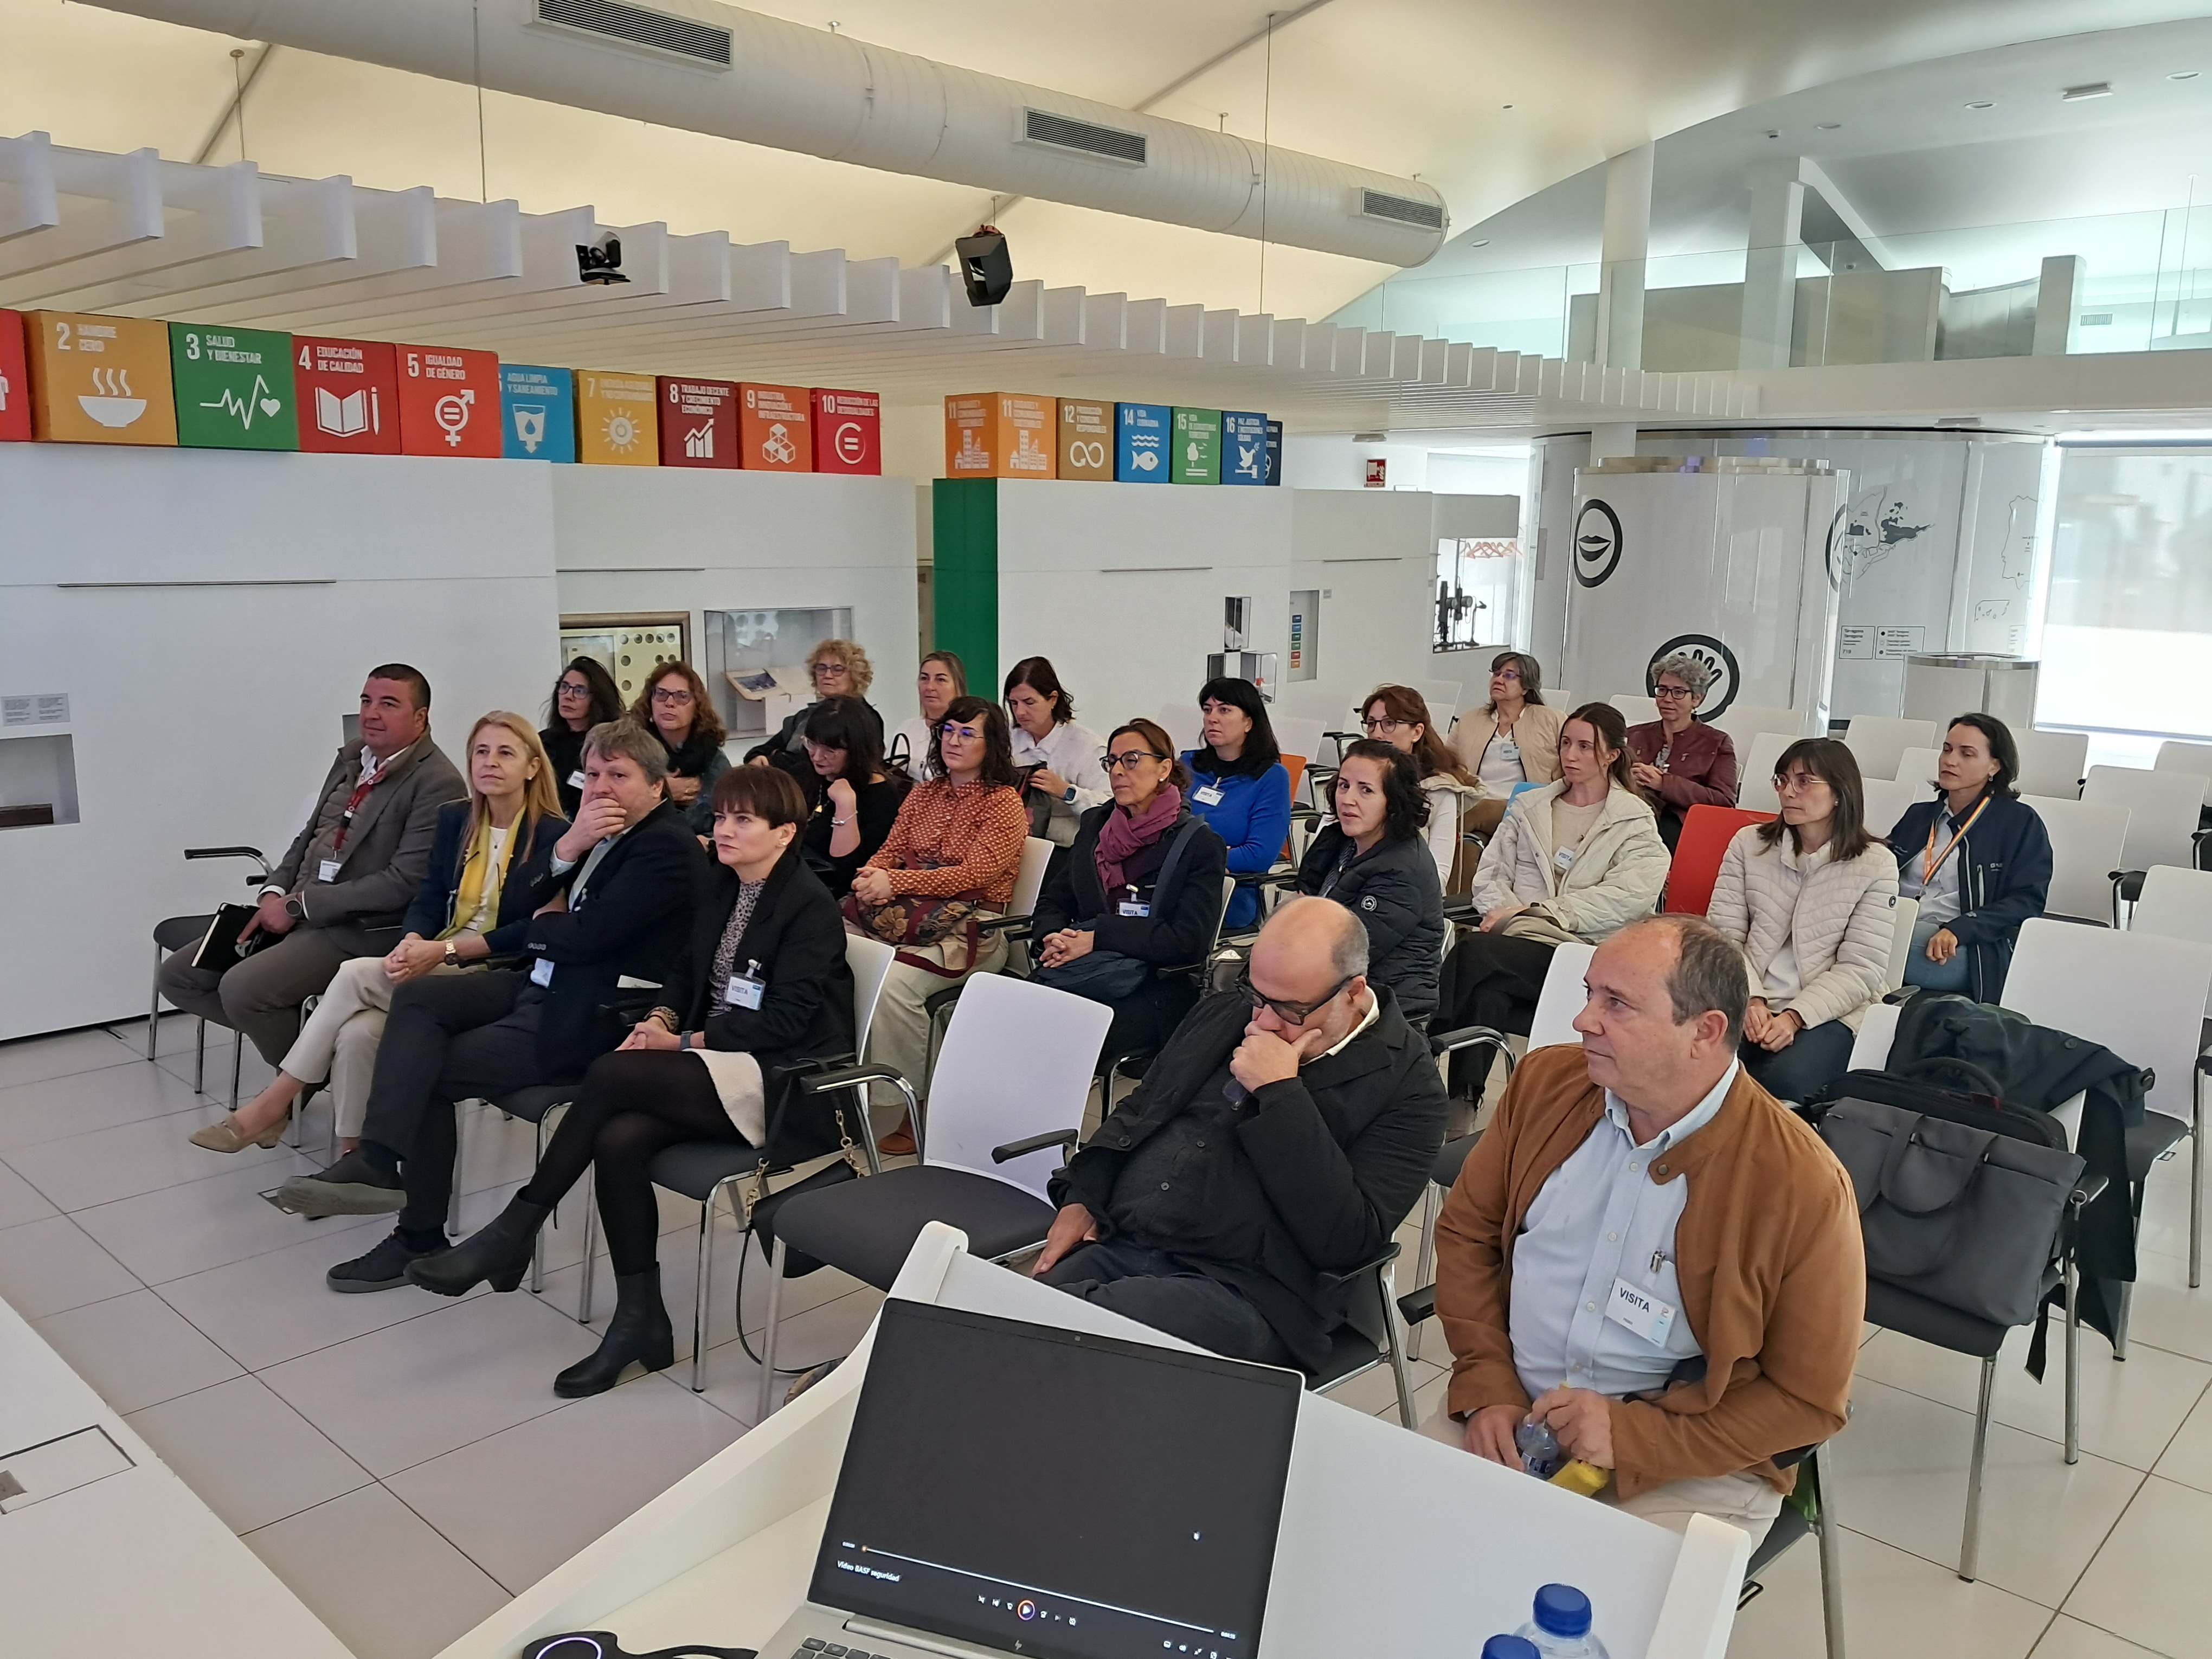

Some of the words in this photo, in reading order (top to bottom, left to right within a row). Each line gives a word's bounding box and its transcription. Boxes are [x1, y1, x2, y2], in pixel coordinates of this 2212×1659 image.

[56, 322, 71, 350] 2
[205, 335, 235, 348] SALUD
[186, 333, 200, 360] 3
[207, 349, 213, 361] Y
[215, 350, 262, 364] BIENESTAR
[298, 345, 312, 370] 4
[407, 353, 420, 377] 5
[425, 354, 462, 367] IGUALDAD
[318, 359, 329, 371] DE
[329, 361, 364, 374] CALIDAD
[426, 367, 436, 378] DE
[436, 367, 465, 380] GÉNERO
[587, 377, 595, 397] 7
[670, 383, 679, 403] 8
[747, 389, 755, 409] 9
[822, 394, 835, 414] 10
[1003, 399, 1012, 417] 11
[949, 402, 956, 419] 11
[1064, 405, 1075, 423] 12
[1124, 409, 1134, 425] 14
[1177, 414, 1187, 430] 15
[1226, 417, 1236, 434] 16
[1620, 1287, 1649, 1313] VISITA
[854, 1565, 871, 1574] BASF
[870, 1570, 901, 1583] seguridad
